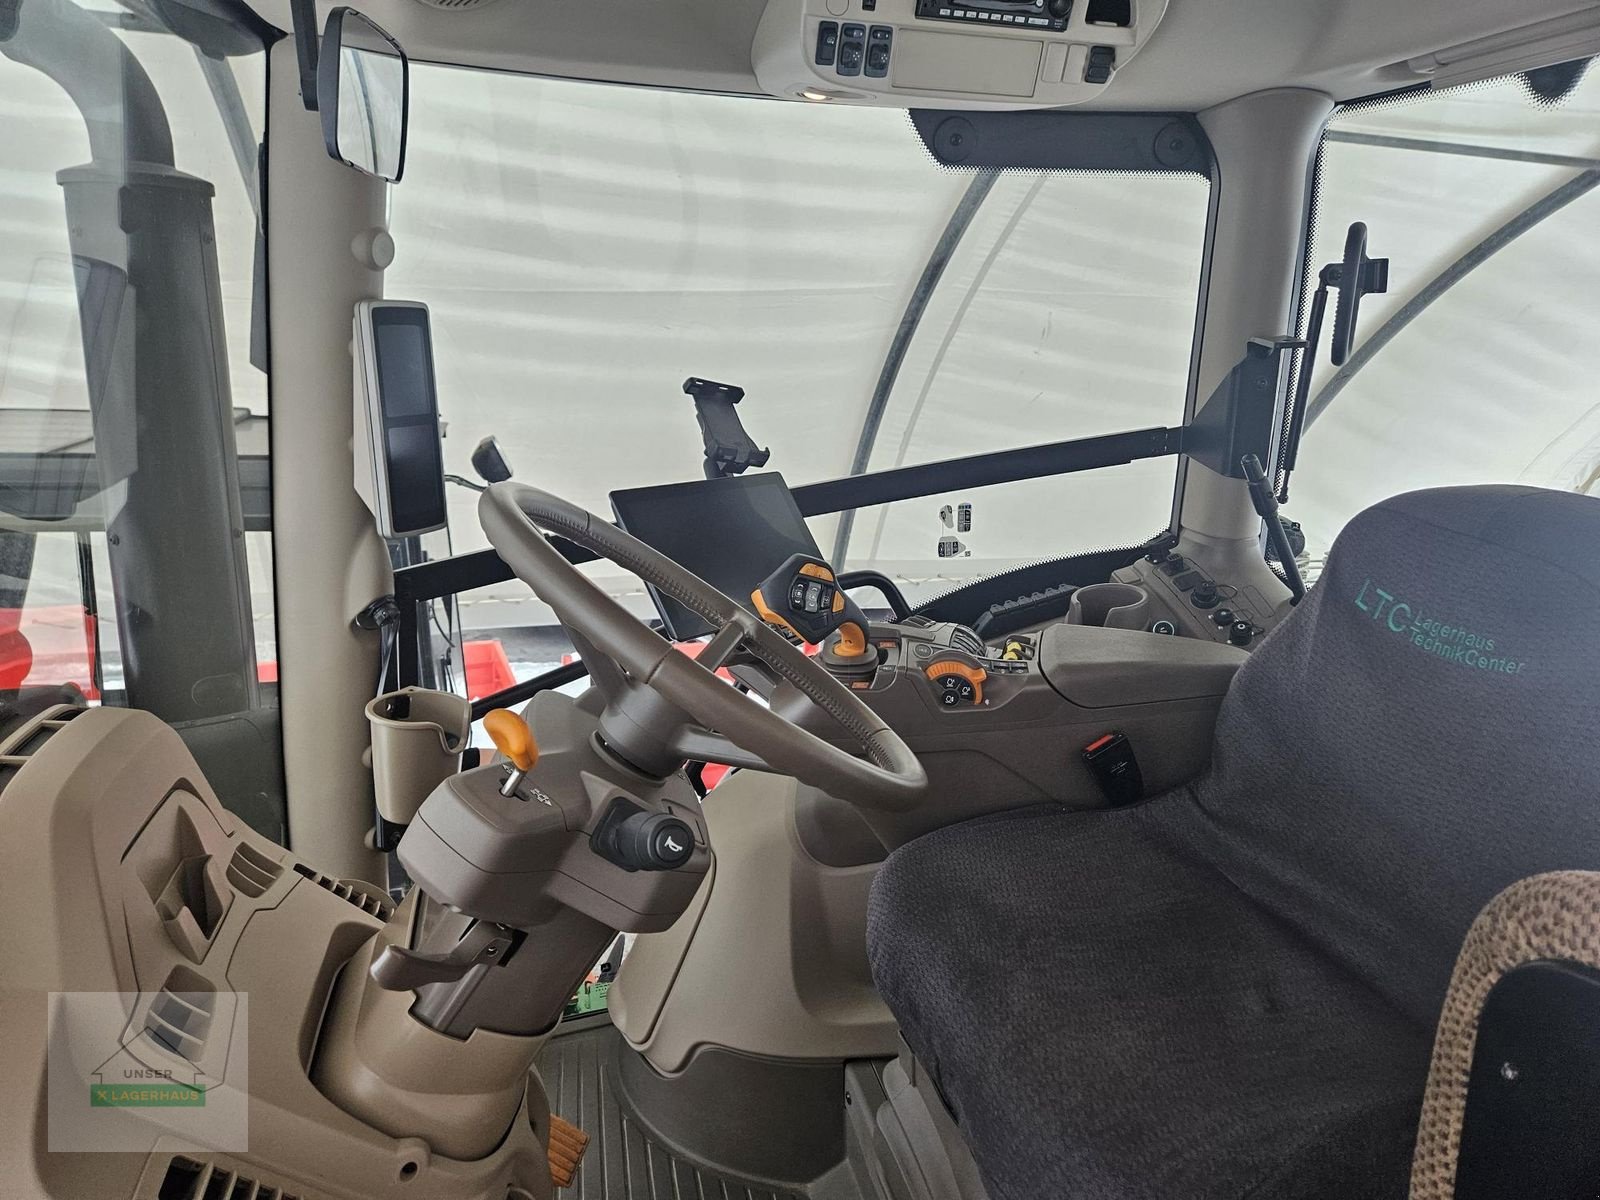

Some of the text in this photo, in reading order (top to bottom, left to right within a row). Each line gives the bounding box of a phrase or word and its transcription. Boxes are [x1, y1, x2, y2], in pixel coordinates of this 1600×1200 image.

[1354, 578, 1412, 632] LTC
[1409, 626, 1526, 674] TechnikCenter
[1413, 609, 1496, 652] Lagerhaus
